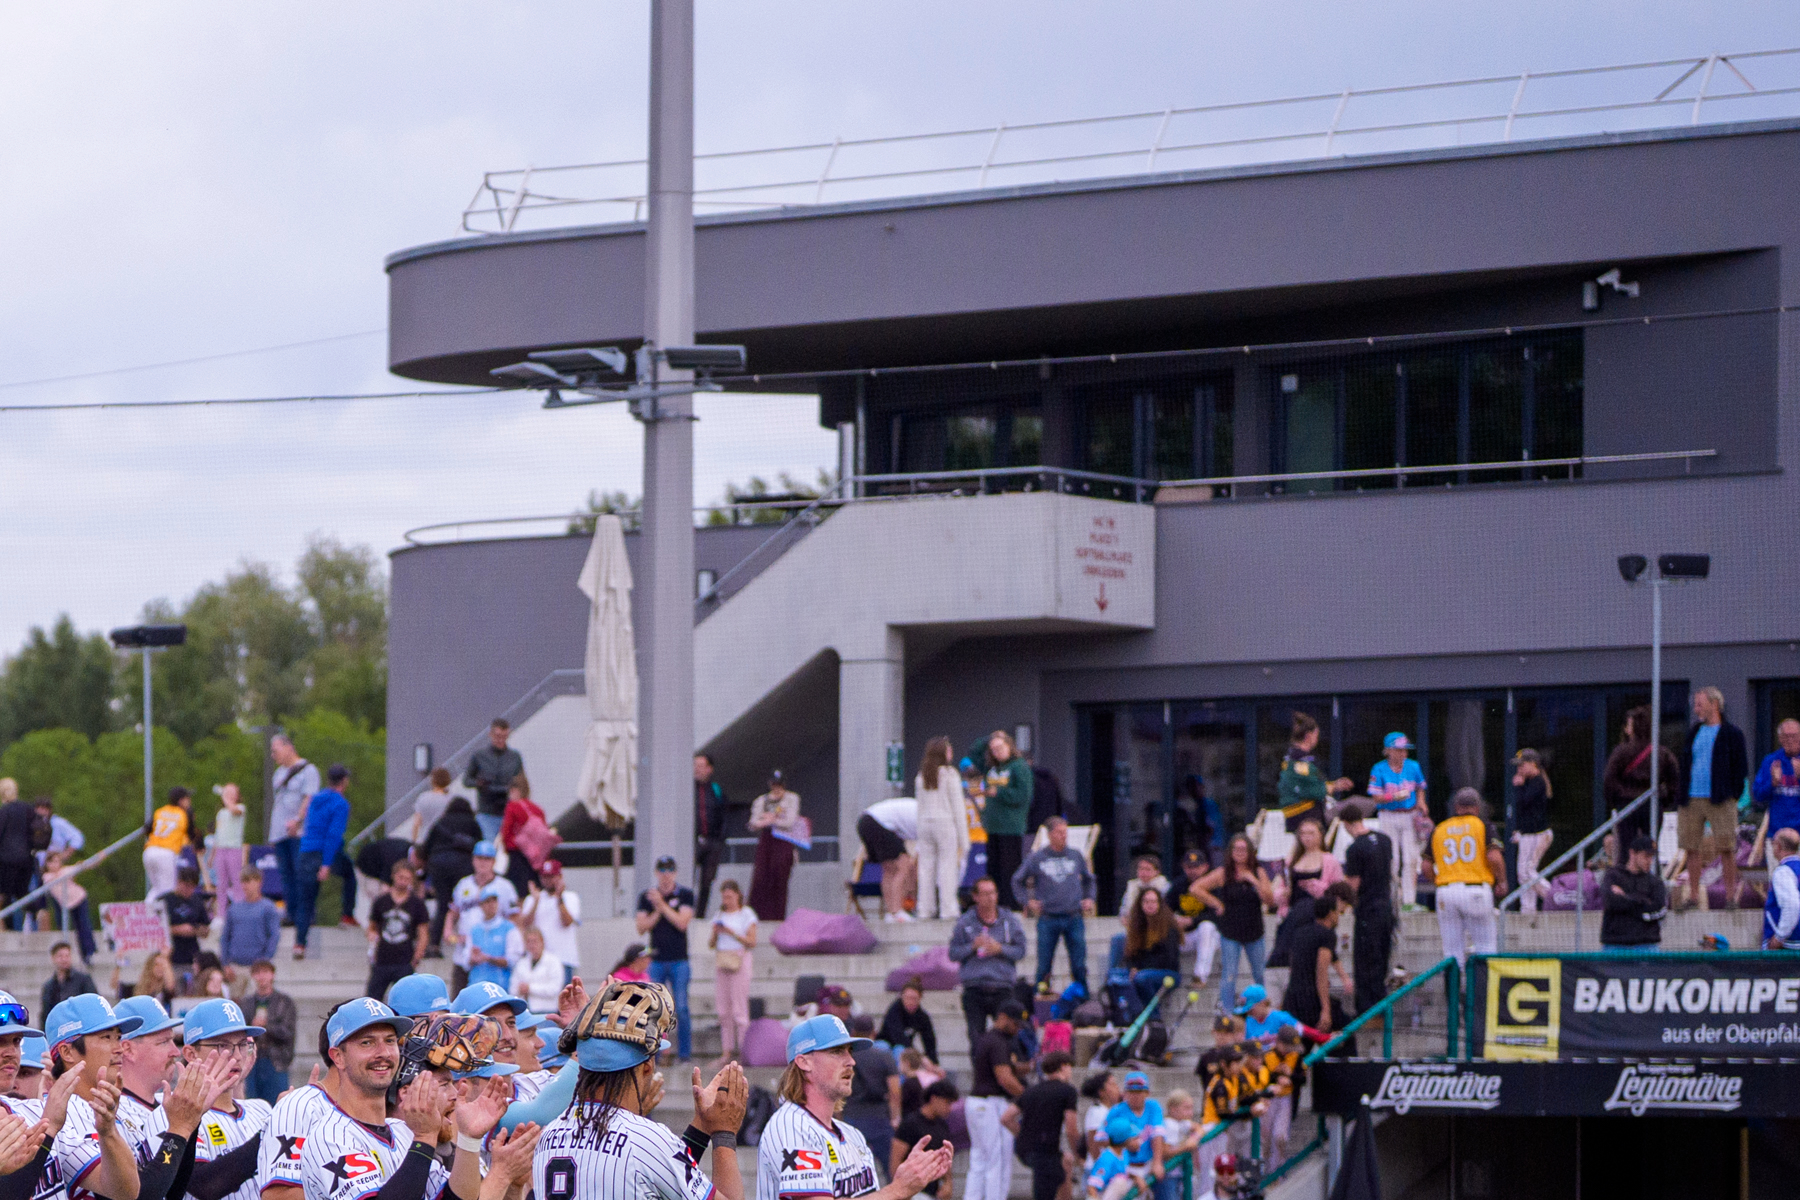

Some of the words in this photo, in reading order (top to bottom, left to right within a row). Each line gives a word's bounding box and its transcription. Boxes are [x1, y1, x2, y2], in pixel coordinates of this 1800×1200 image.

[1443, 836, 1477, 865] 30
[482, 981, 503, 999] R
[1574, 977, 1800, 1014] BAUKOMPE
[222, 1002, 241, 1023] R
[363, 997, 387, 1018] R
[1662, 1027, 1691, 1044] aus
[1694, 1023, 1722, 1044] der
[1725, 1022, 1800, 1047] Oberpfal
[1369, 1065, 1502, 1116] Legionäre
[1603, 1066, 1742, 1117] Legionäre
[781, 1147, 823, 1173] XS
[322, 1152, 378, 1196] XS
